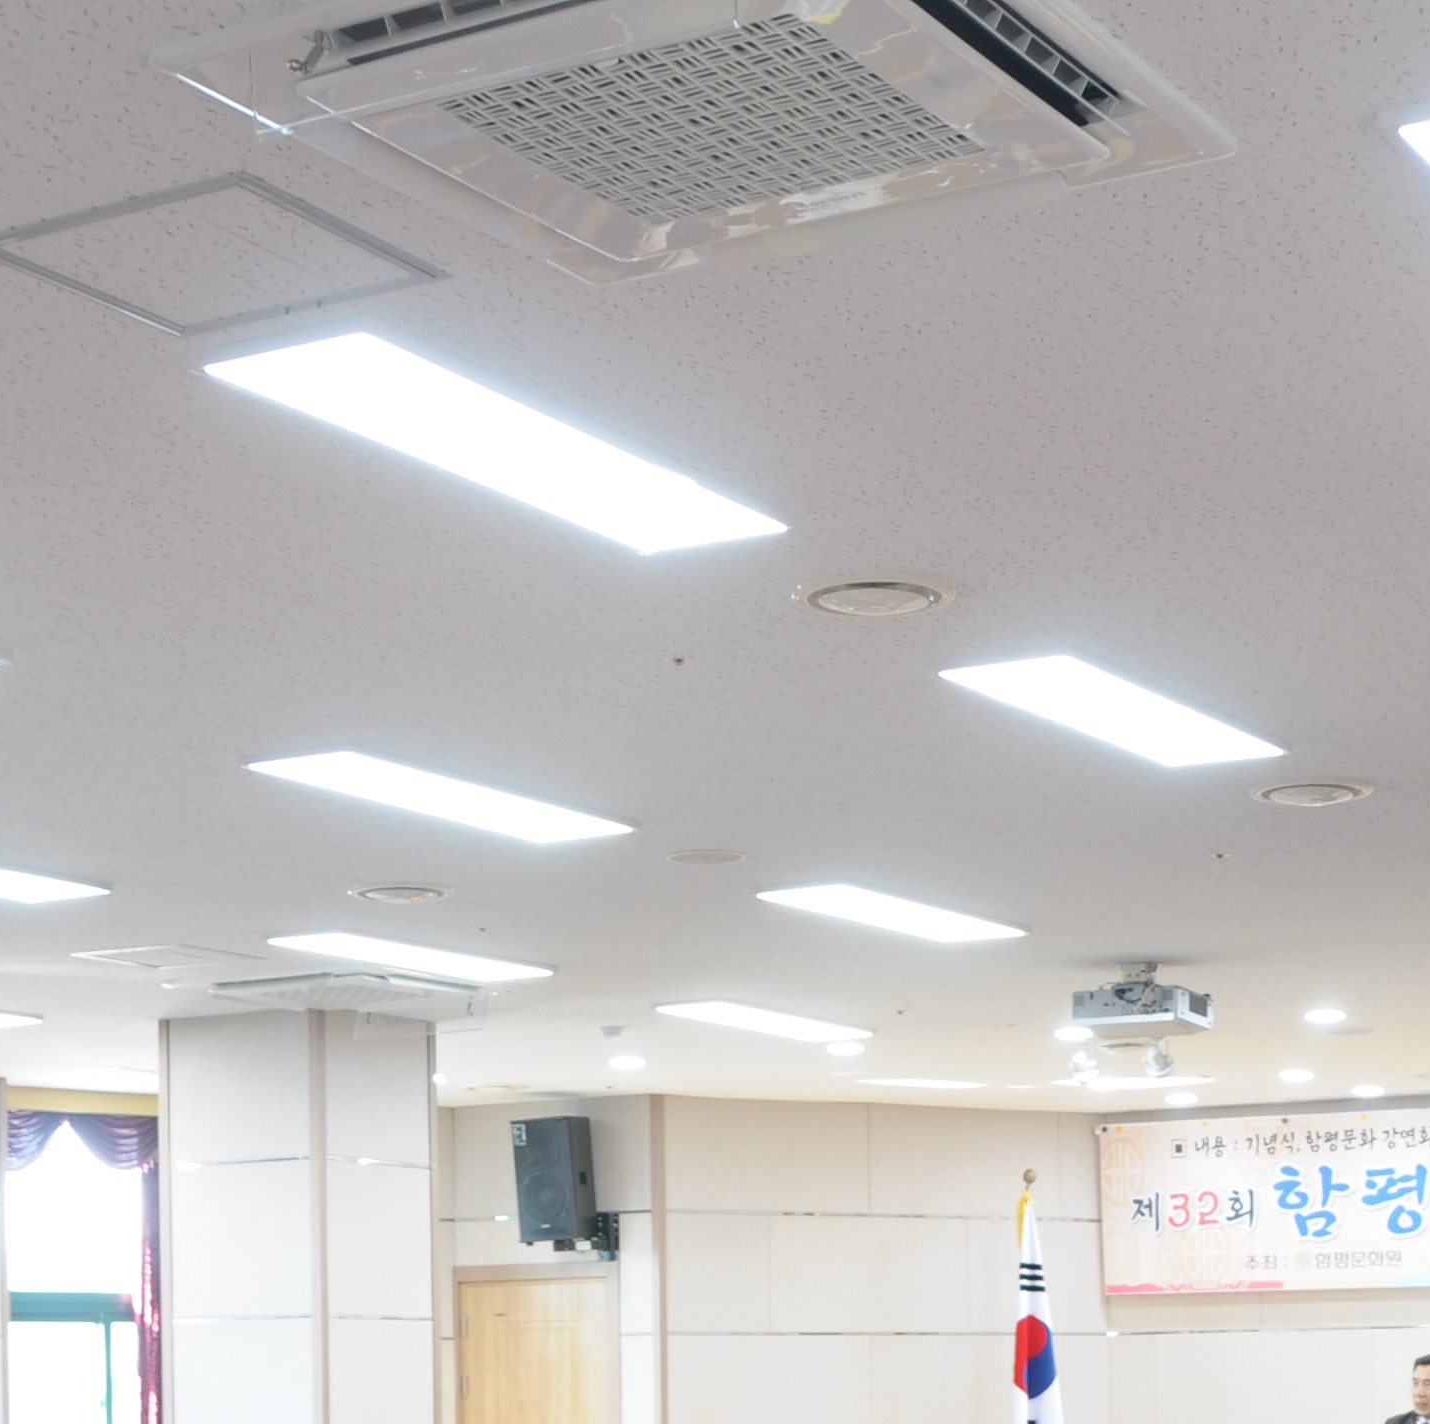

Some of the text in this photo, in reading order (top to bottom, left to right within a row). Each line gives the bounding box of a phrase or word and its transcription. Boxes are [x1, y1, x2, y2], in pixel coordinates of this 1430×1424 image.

[1194, 1135, 1226, 1158] 내용
[1305, 1130, 1376, 1152] 함평문화
[1132, 1189, 1257, 1232] 제32회
[1245, 1253, 1277, 1270] 주최
[1315, 1250, 1403, 1269] 함평문화원
